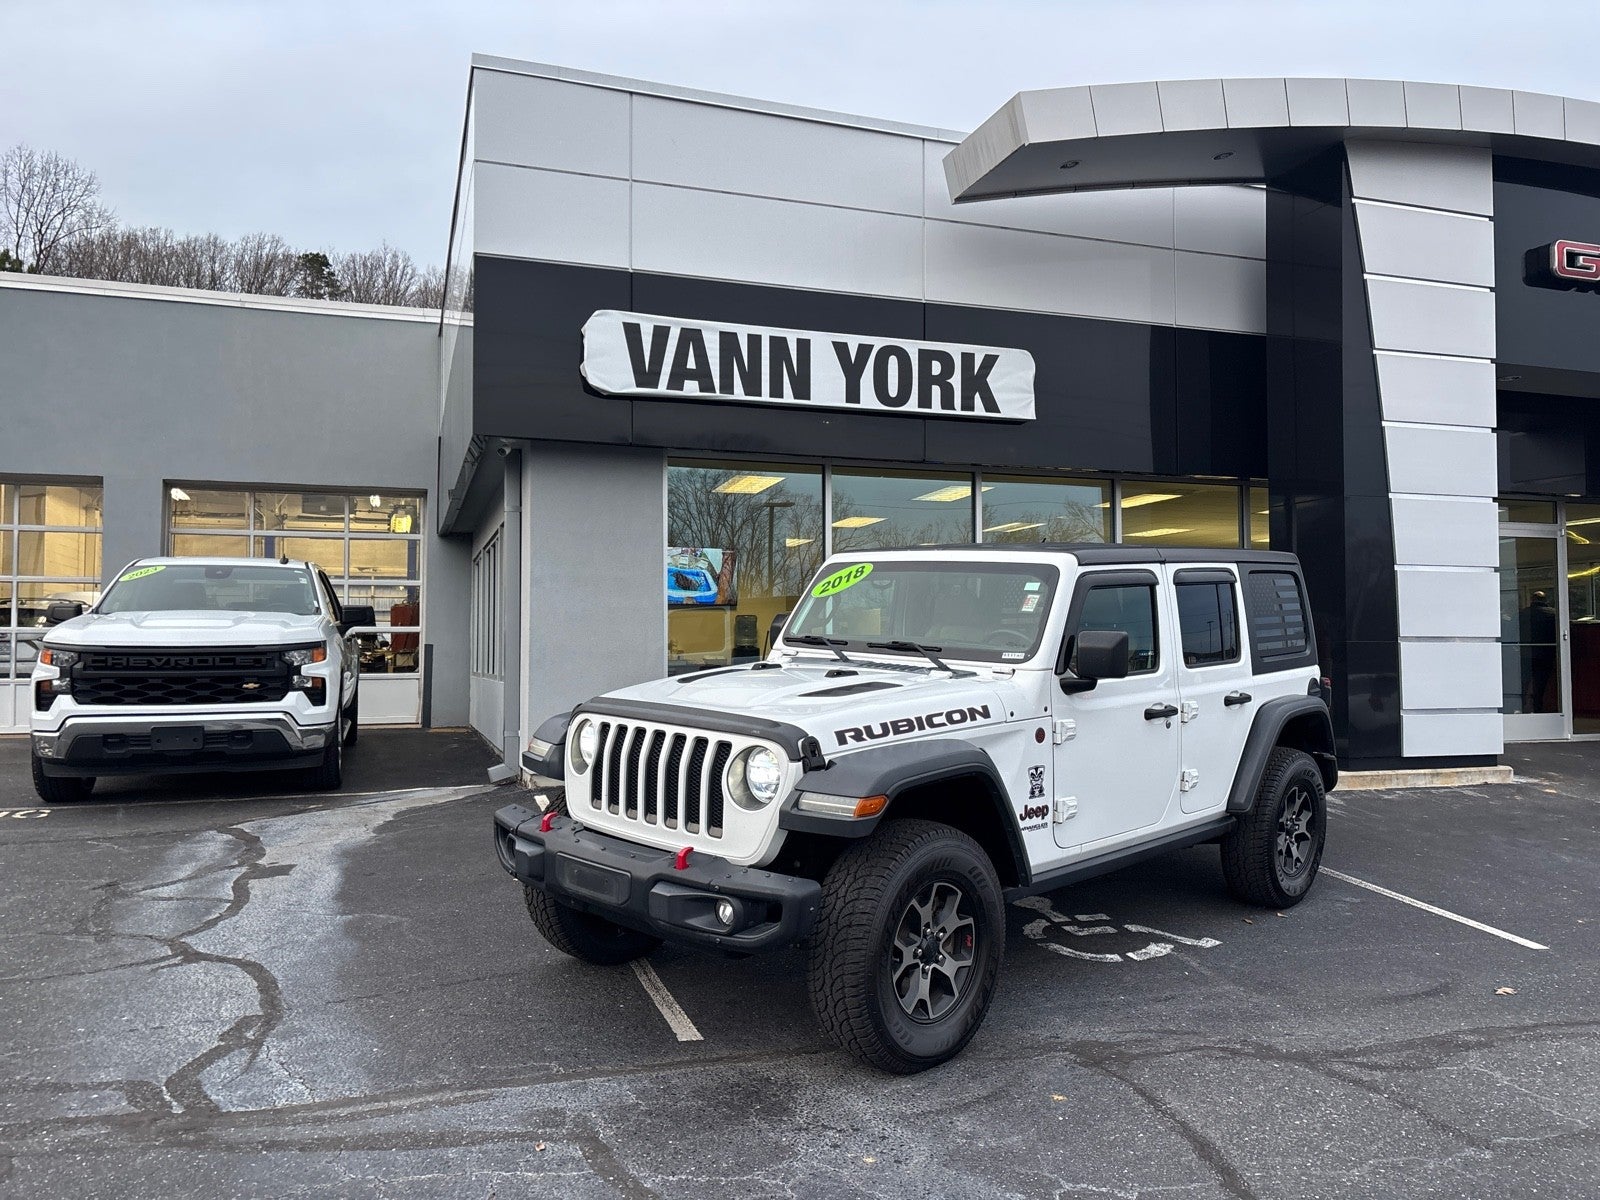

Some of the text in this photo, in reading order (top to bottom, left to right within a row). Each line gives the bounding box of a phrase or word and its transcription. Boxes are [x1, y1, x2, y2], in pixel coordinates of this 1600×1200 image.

[622, 322, 1002, 414] VANN YORK
[818, 565, 866, 595] 2018
[88, 656, 274, 667] CHEVROLET
[834, 704, 992, 746] RUBICON
[1019, 804, 1049, 821] Jeep
